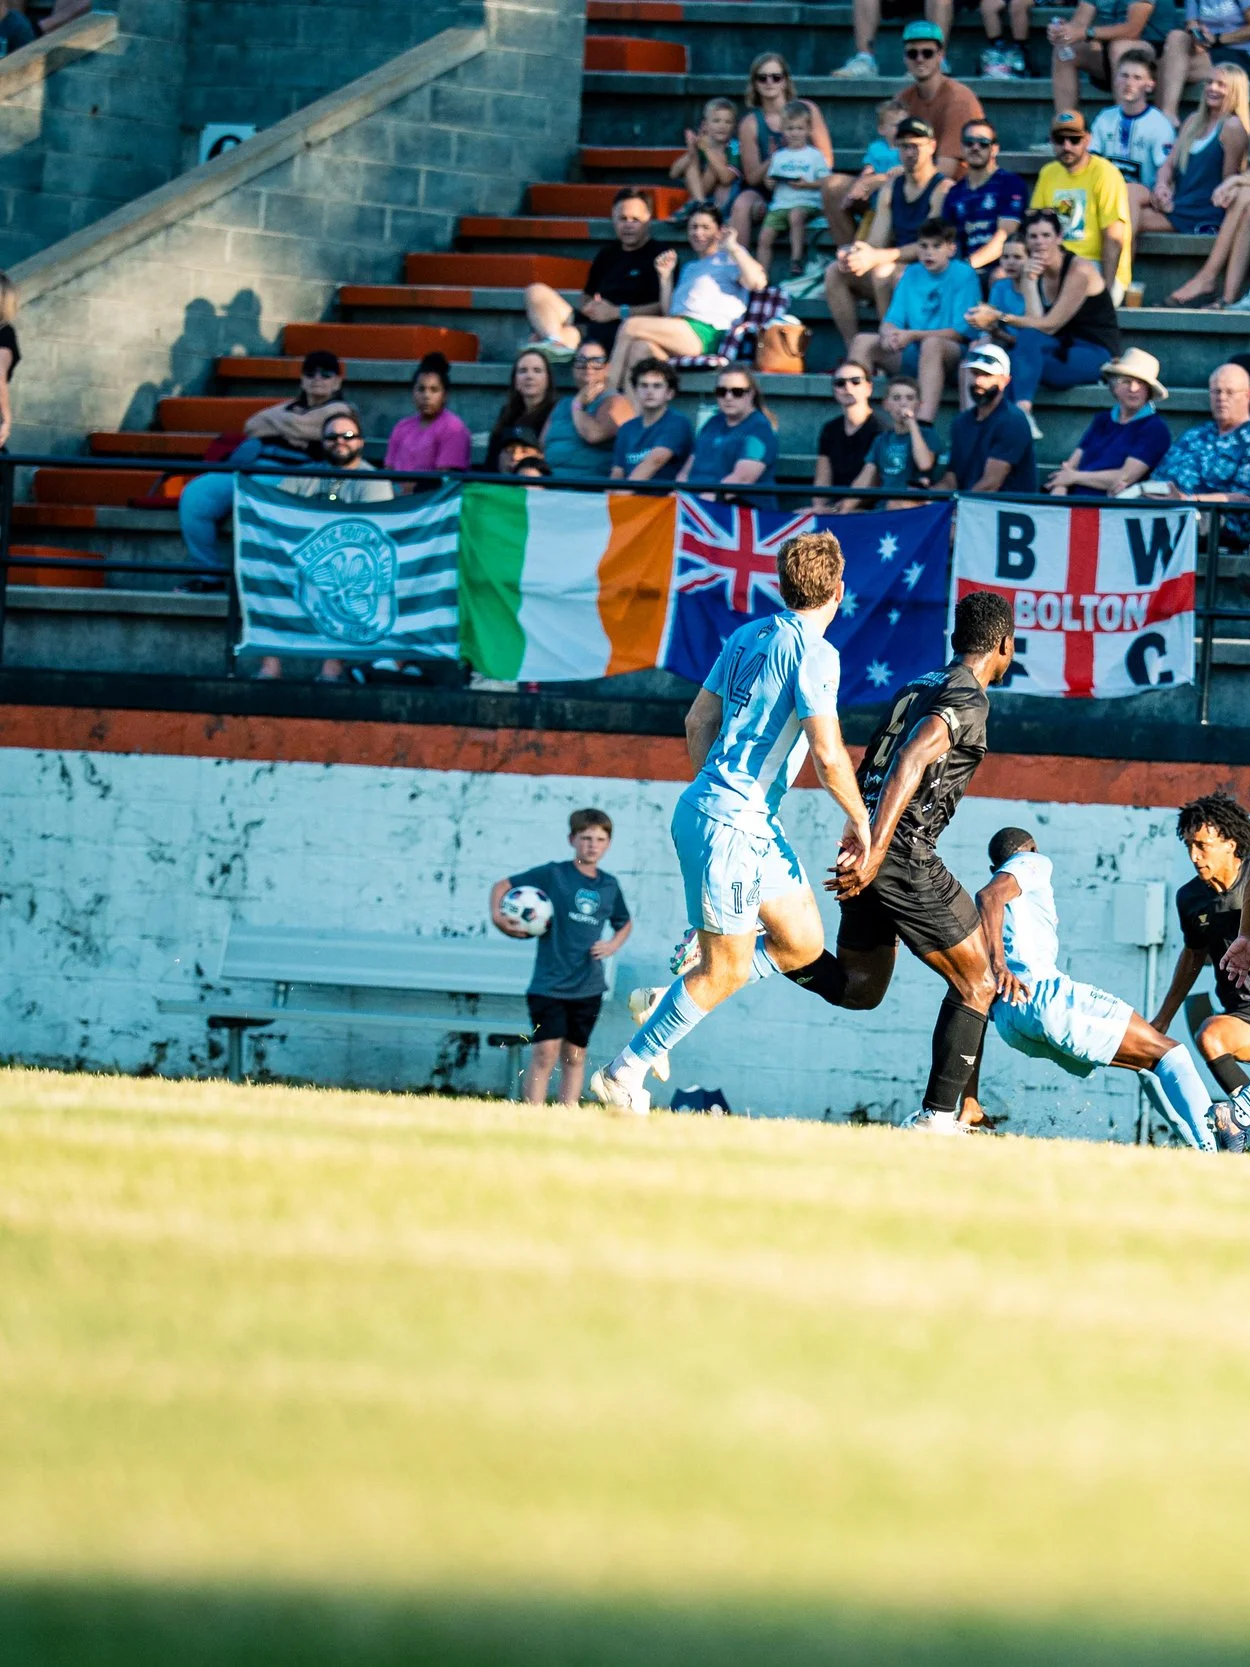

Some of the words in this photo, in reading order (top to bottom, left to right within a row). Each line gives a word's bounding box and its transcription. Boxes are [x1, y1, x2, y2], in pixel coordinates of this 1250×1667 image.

[995, 510, 1036, 580] B
[1125, 515, 1187, 586] W
[1014, 590, 1151, 632] BOLTON
